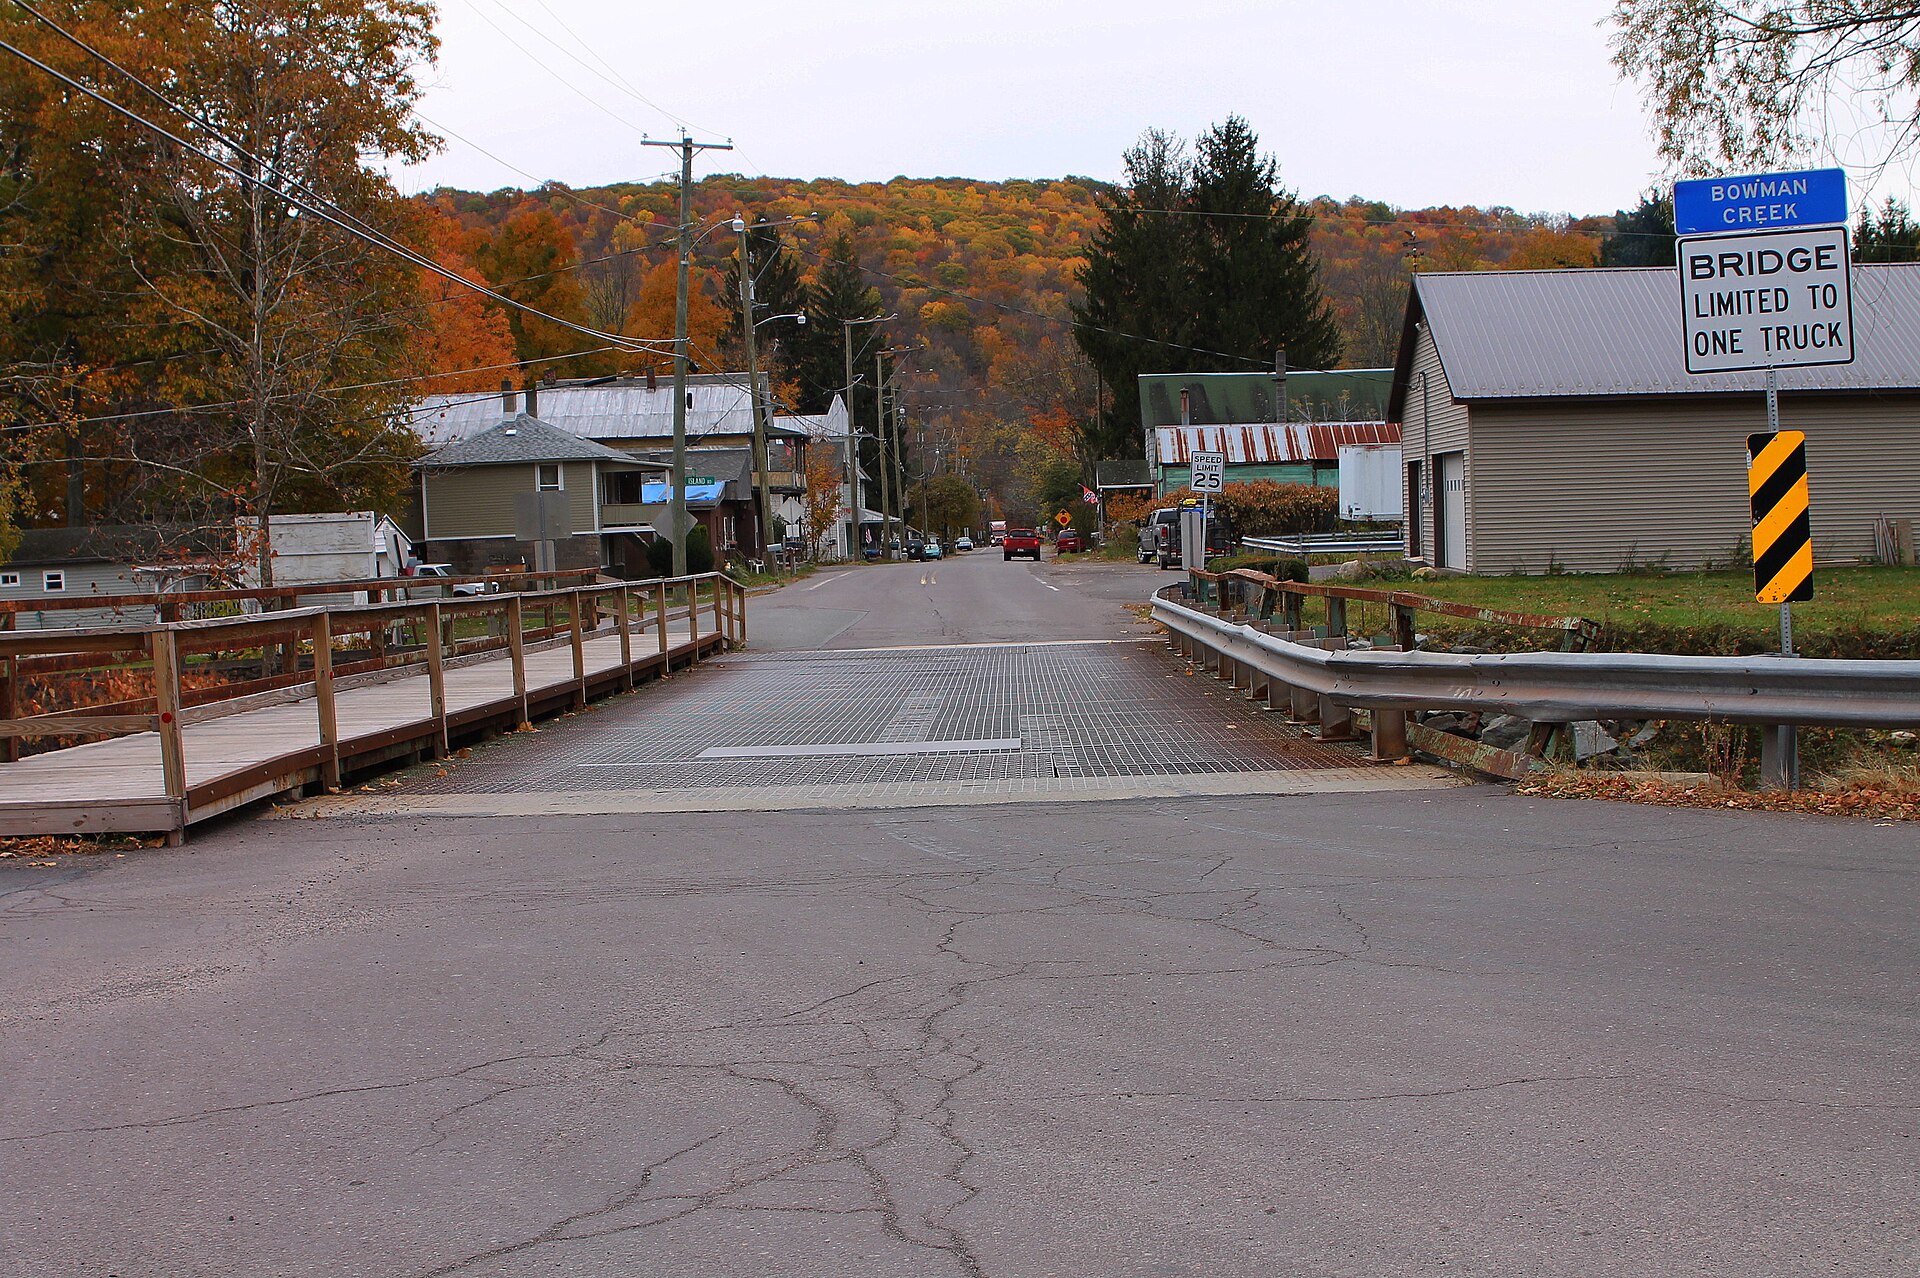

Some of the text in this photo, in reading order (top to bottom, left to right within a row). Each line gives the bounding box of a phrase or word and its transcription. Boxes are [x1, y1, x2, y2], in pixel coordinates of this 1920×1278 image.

[1711, 178, 1808, 202] BOWMAN
[1723, 203, 1798, 224] CREEK
[1690, 244, 1838, 280] BRIDGE
[1694, 283, 1838, 319] LIMITED TO
[1694, 321, 1843, 357] ONE TRUCK
[1194, 455, 1222, 464] SPEED
[1196, 464, 1218, 472] LIMIT
[688, 477, 706, 485] ISLAND
[1193, 472, 1220, 489] 25
